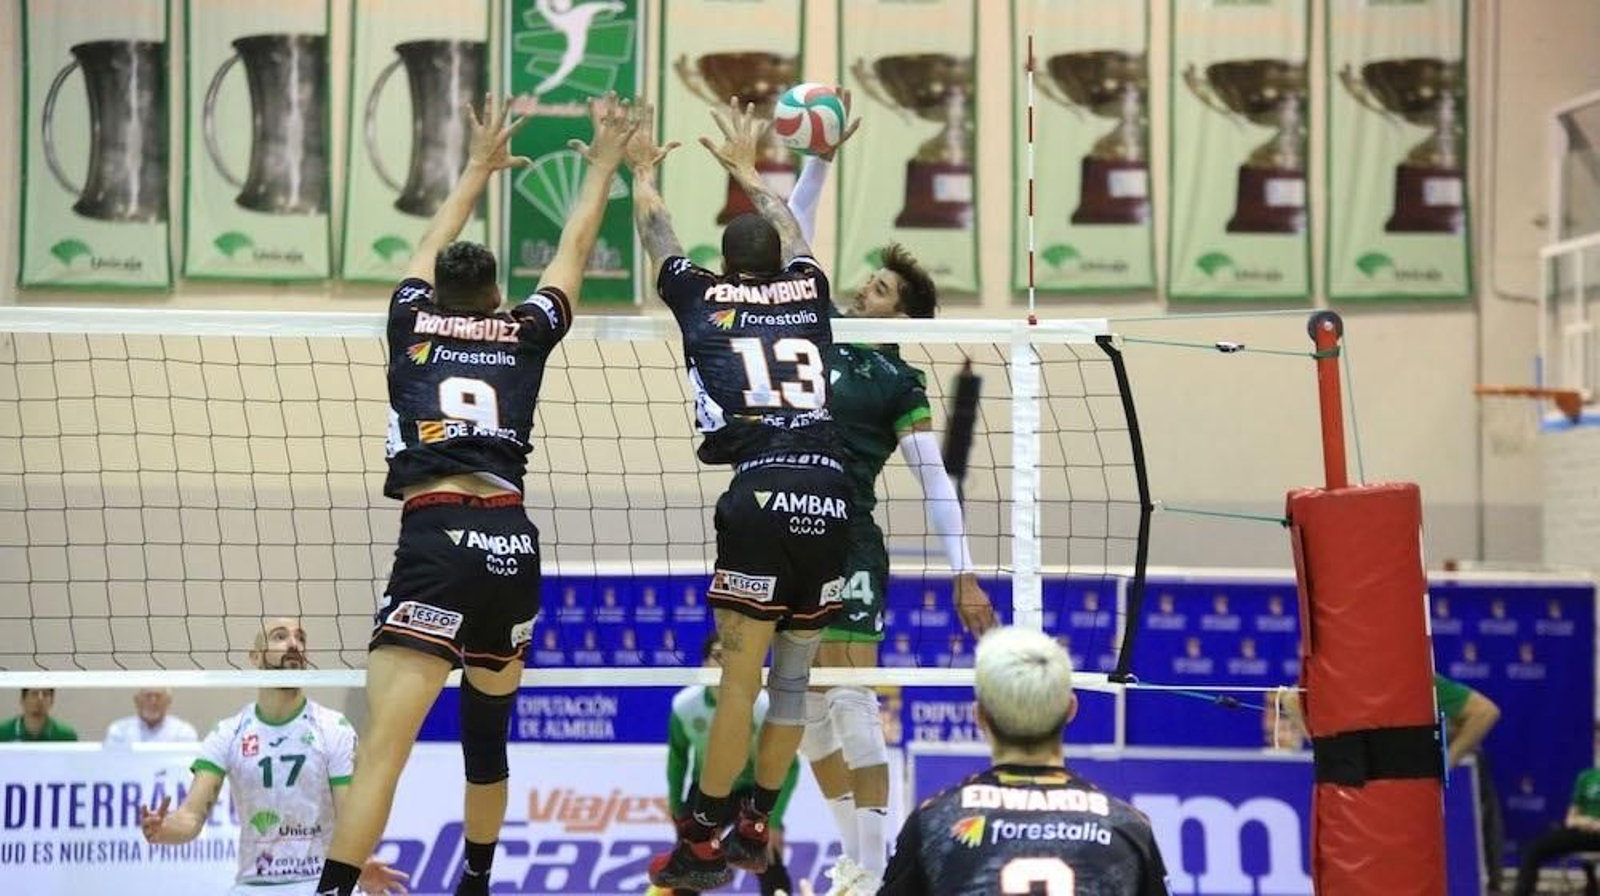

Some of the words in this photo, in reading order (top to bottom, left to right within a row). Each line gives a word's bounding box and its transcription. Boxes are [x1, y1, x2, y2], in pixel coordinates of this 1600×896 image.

[740, 310, 818, 328] forestalia
[432, 345, 516, 366] forestalia
[729, 337, 827, 409] 13
[438, 377, 500, 431] 9
[772, 491, 848, 520] AMBAR
[467, 530, 535, 555] AMBAR
[258, 754, 307, 789] 17
[961, 784, 1110, 817] EDWARDS
[991, 819, 1112, 846] forestalia
[33, 841, 54, 864] ES
[60, 839, 142, 863] NUESTRA
